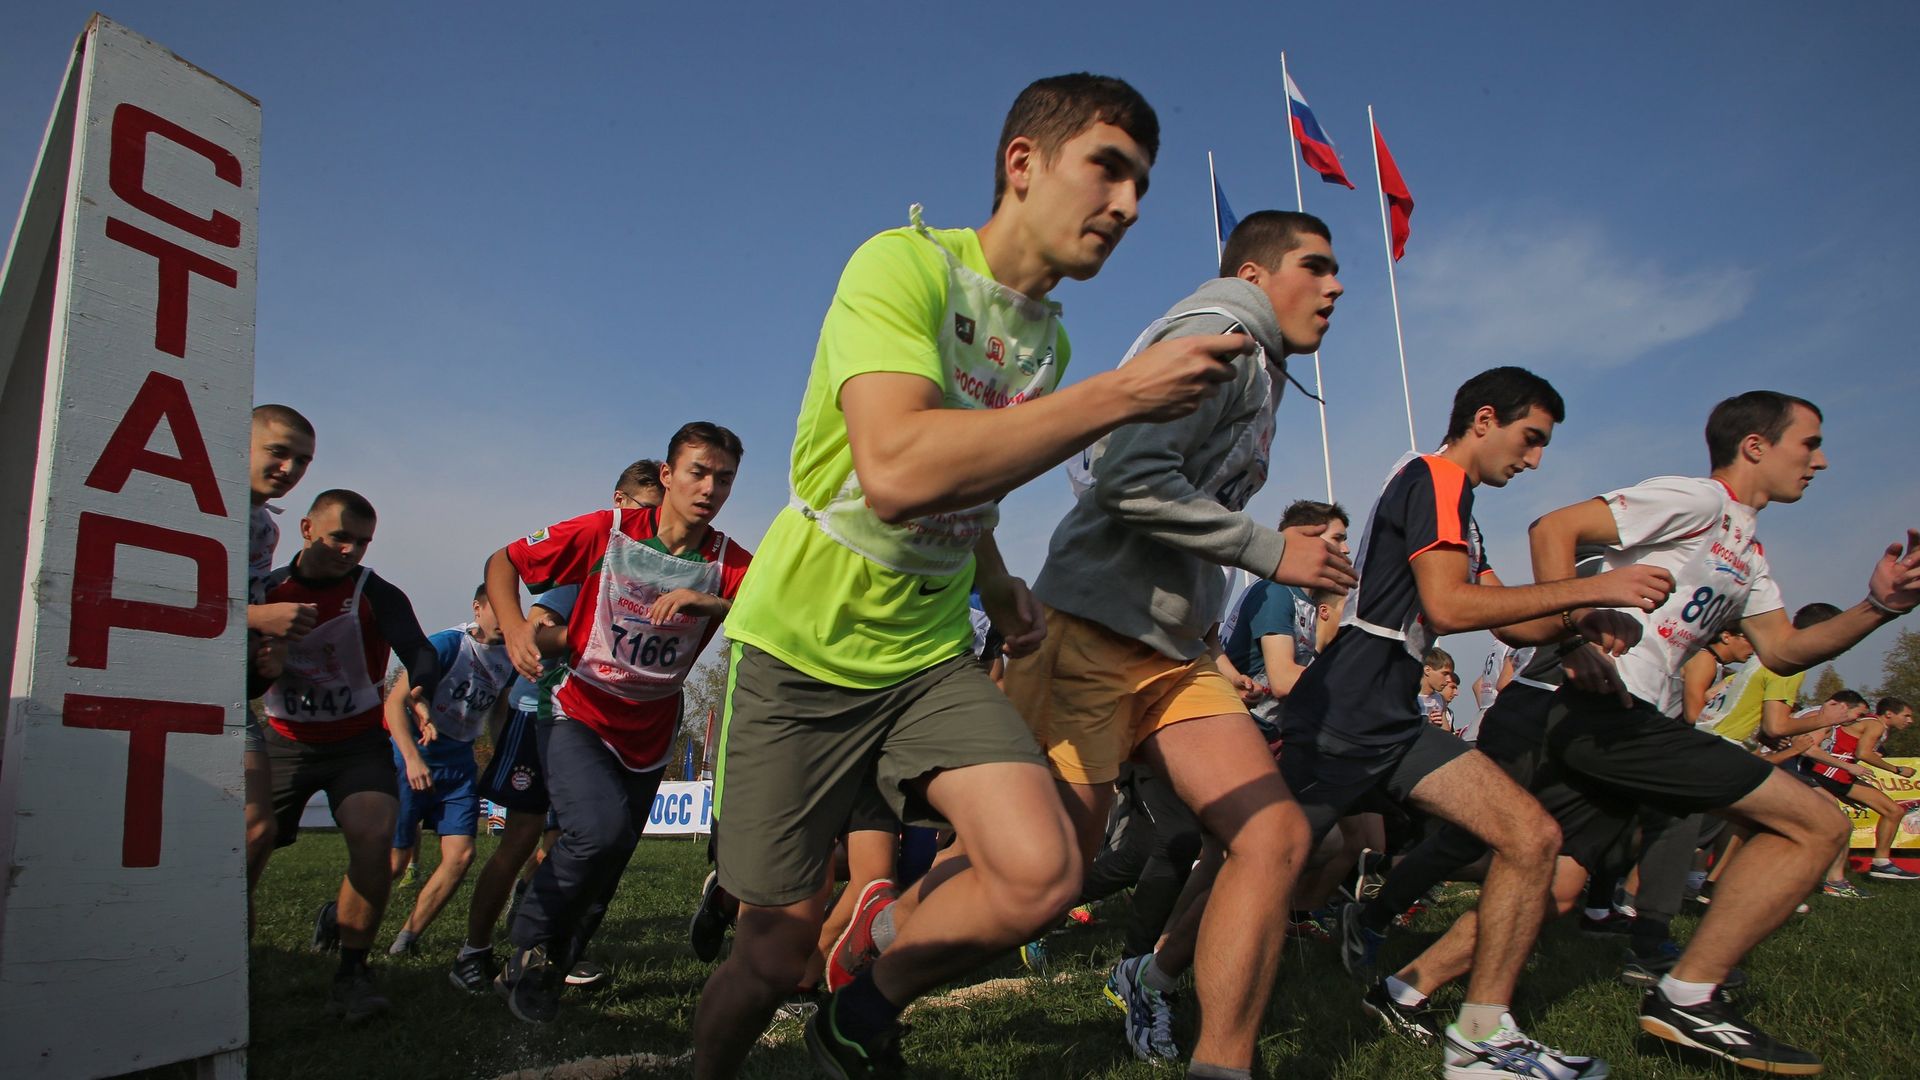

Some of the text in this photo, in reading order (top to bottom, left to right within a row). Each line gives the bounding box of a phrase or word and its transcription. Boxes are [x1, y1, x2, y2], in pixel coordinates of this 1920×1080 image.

[63, 102, 243, 869] СТАРТ
[617, 596, 645, 616] КРОСС
[611, 623, 680, 667] 7166
[284, 686, 357, 717] 6442
[650, 793, 693, 825] ОСС
